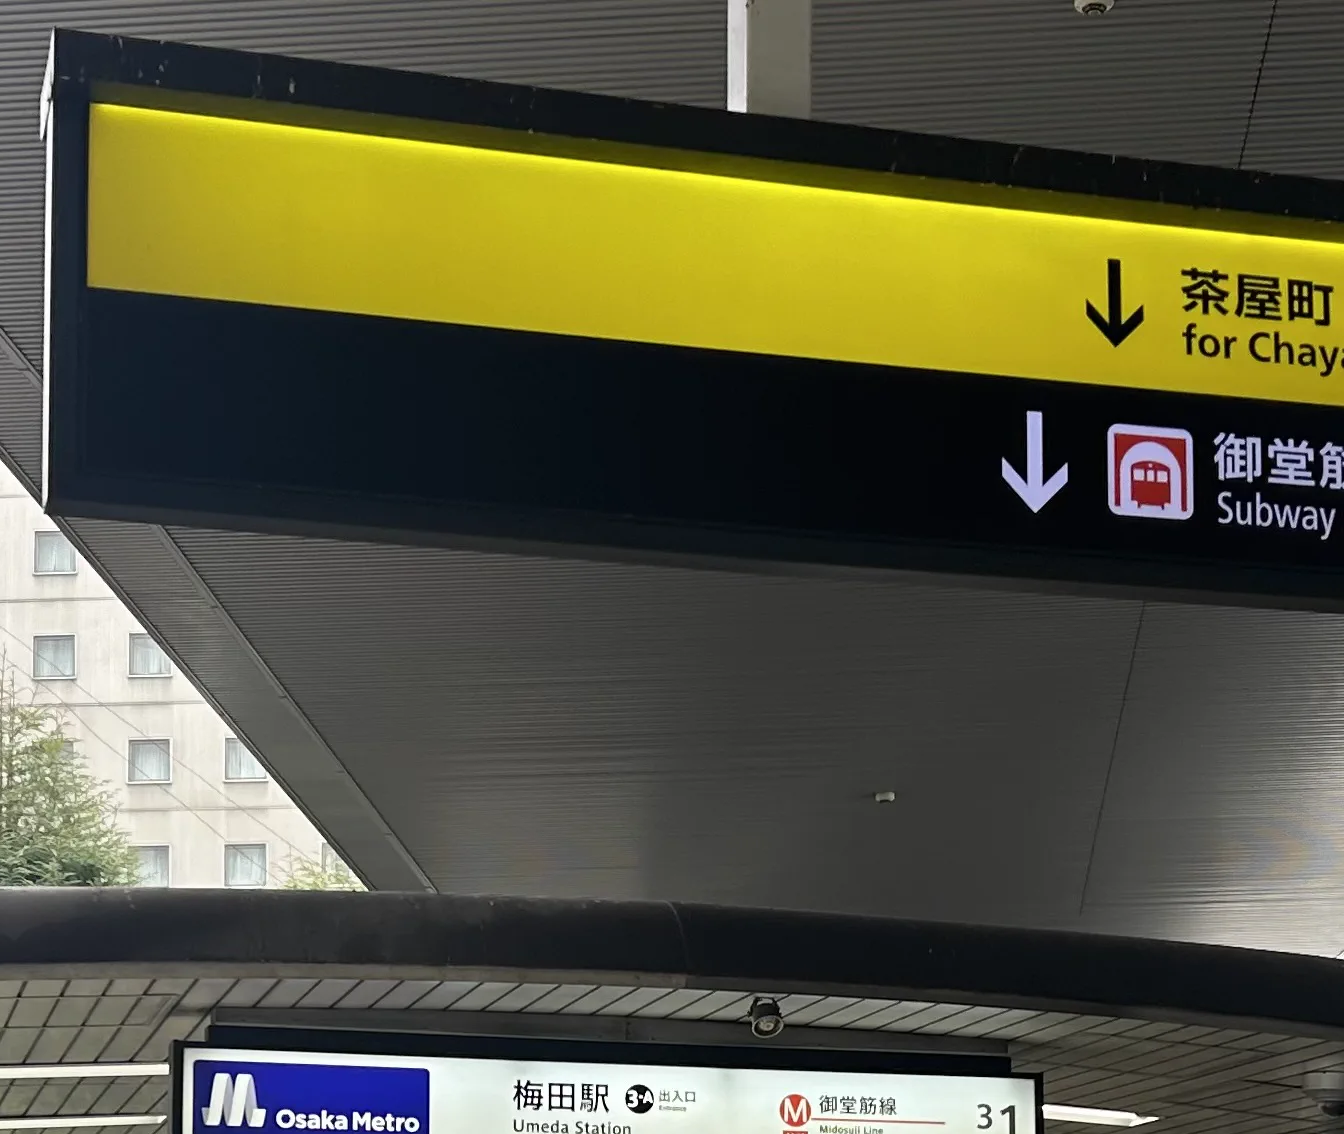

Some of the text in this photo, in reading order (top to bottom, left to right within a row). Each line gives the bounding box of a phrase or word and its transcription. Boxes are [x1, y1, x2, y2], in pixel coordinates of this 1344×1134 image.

[1181, 267, 1335, 327] 茶屋町
[1182, 323, 1238, 360] for
[1217, 491, 1337, 542] Subway
[513, 1079, 610, 1114] 梅田駅
[658, 1089, 696, 1103] 出入口
[782, 1096, 809, 1125] M
[819, 1094, 897, 1116] 御堂筋線
[275, 1109, 420, 1133] Osaka Metro
[513, 1119, 569, 1134] Umeda
